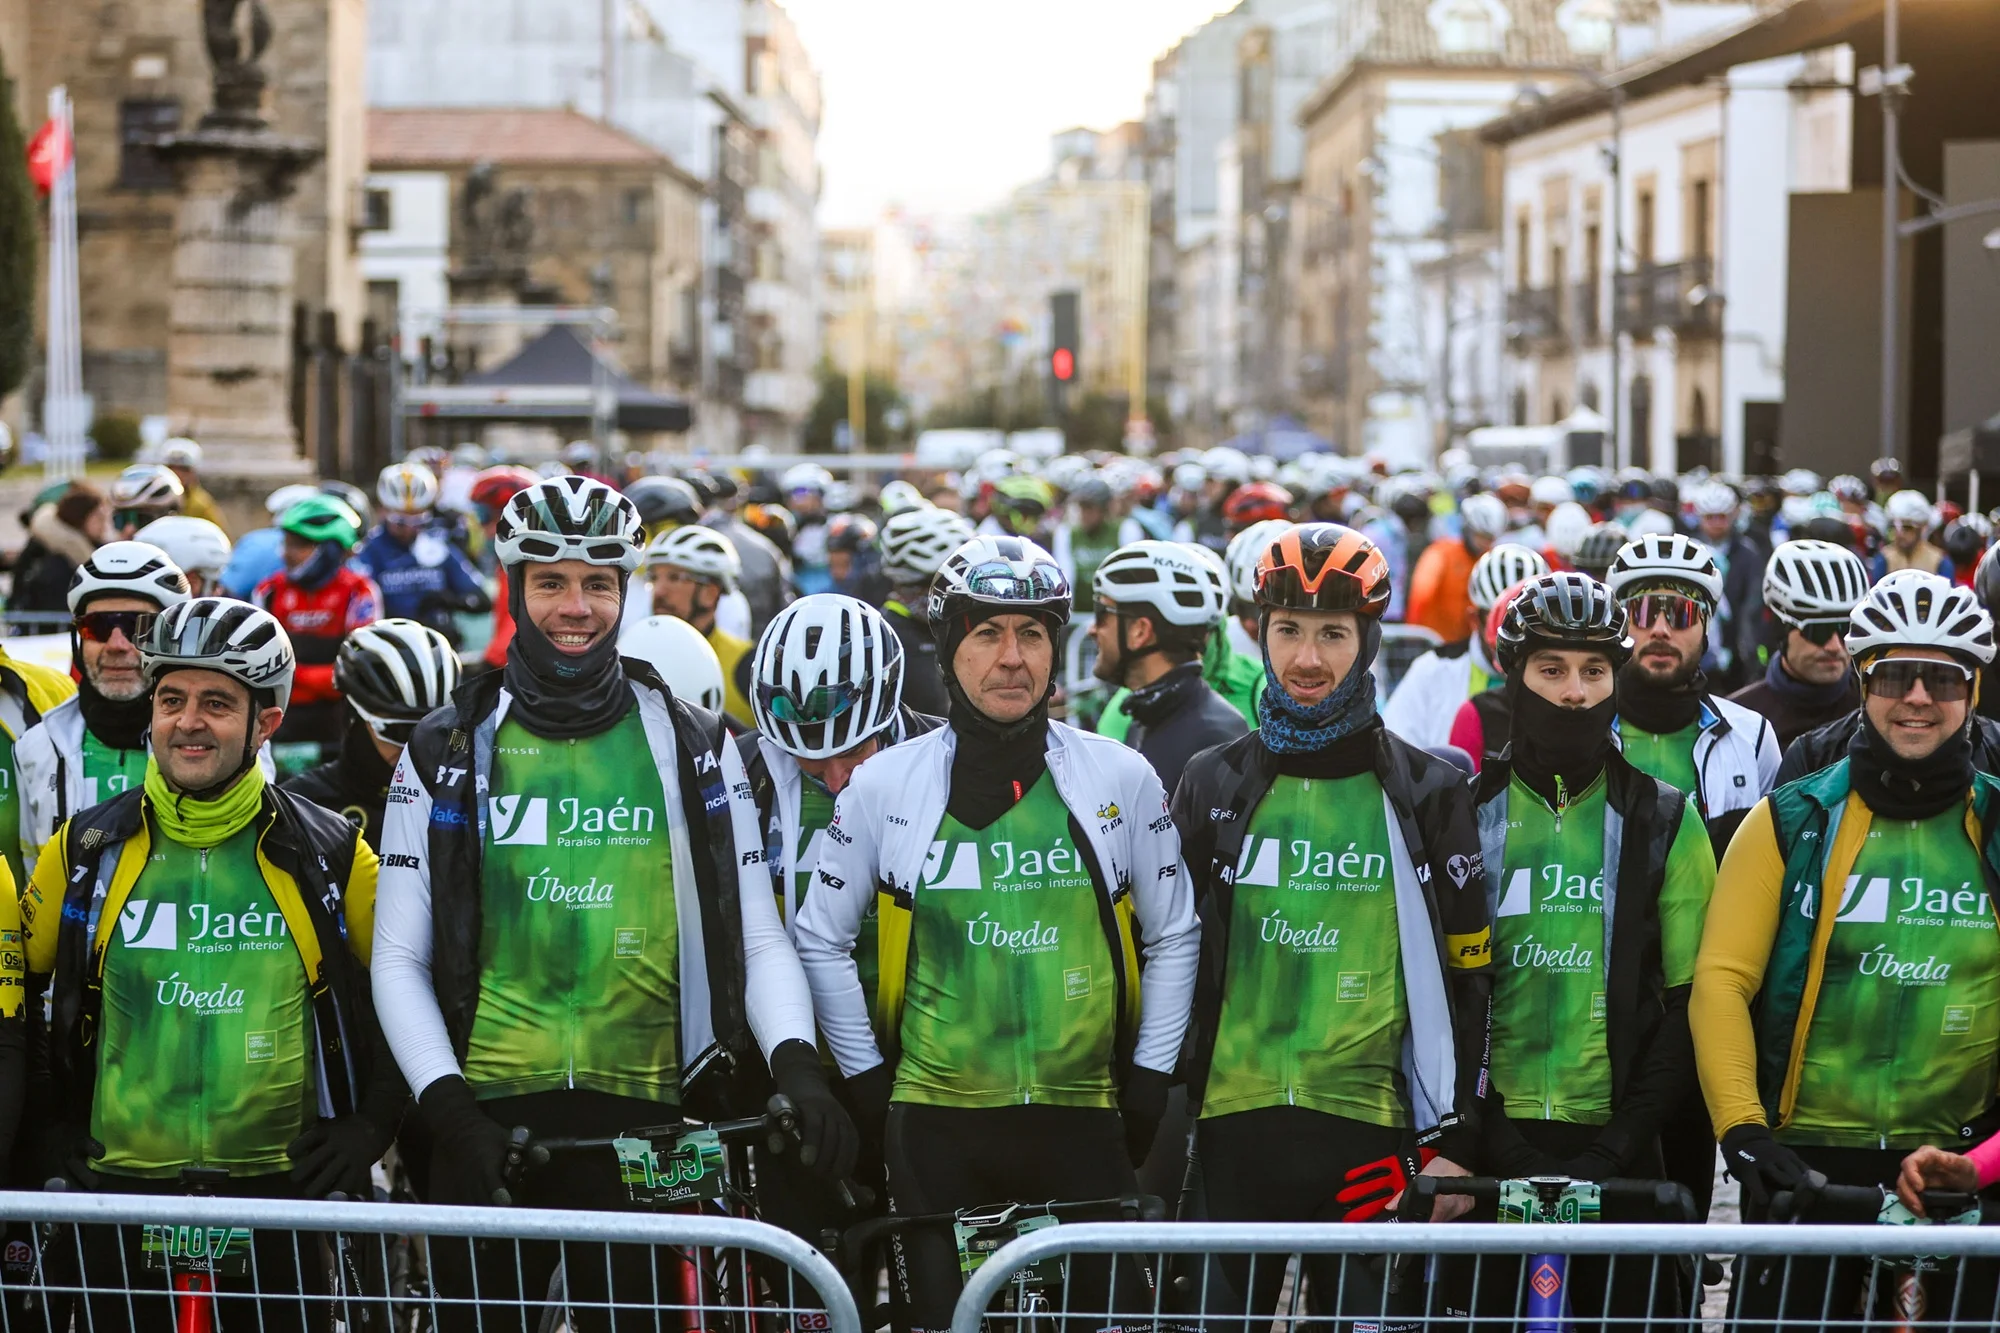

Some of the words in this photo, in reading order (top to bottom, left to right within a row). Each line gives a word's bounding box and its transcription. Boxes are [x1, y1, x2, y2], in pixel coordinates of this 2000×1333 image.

[1153, 557, 1194, 573] KASK
[498, 747, 540, 755] PISSEI
[558, 796, 655, 835] Jaén
[557, 836, 601, 847] Paraíso
[607, 835, 652, 846] interior
[1290, 842, 1386, 879] Jaén
[526, 866, 614, 902] Úbeda
[992, 880, 1042, 893] Paraíso
[1288, 879, 1330, 891] Paraíso
[1335, 881, 1381, 893] interior
[1541, 864, 1603, 901] Jaé
[565, 902, 613, 911] Ayuntamiento
[1540, 902, 1583, 913] Paraíso
[187, 902, 287, 941] Jaén
[1260, 908, 1340, 947] Úbeda
[1896, 915, 1945, 927] Paraíso
[1950, 917, 1996, 930] interior
[965, 911, 1059, 948] Úbeda
[187, 942, 233, 954] Paraíso
[238, 940, 285, 951] interior
[1010, 945, 1059, 957] Ayuntamiento
[1292, 945, 1338, 954] Ayuntamiento
[1460, 944, 1481, 957] FS
[1511, 934, 1593, 968] Úbeda
[1858, 943, 1952, 981] Úbeda
[1547, 966, 1592, 974] Ayuntamiento
[156, 971, 245, 1009] Úbeda
[1896, 979, 1946, 987] Ayuntamiento
[195, 1007, 244, 1016] Ayuntamiento
[1478, 1069, 1488, 1098] BOSCH
[666, 1185, 692, 1198] Jaén
[169, 1224, 234, 1259] 107
